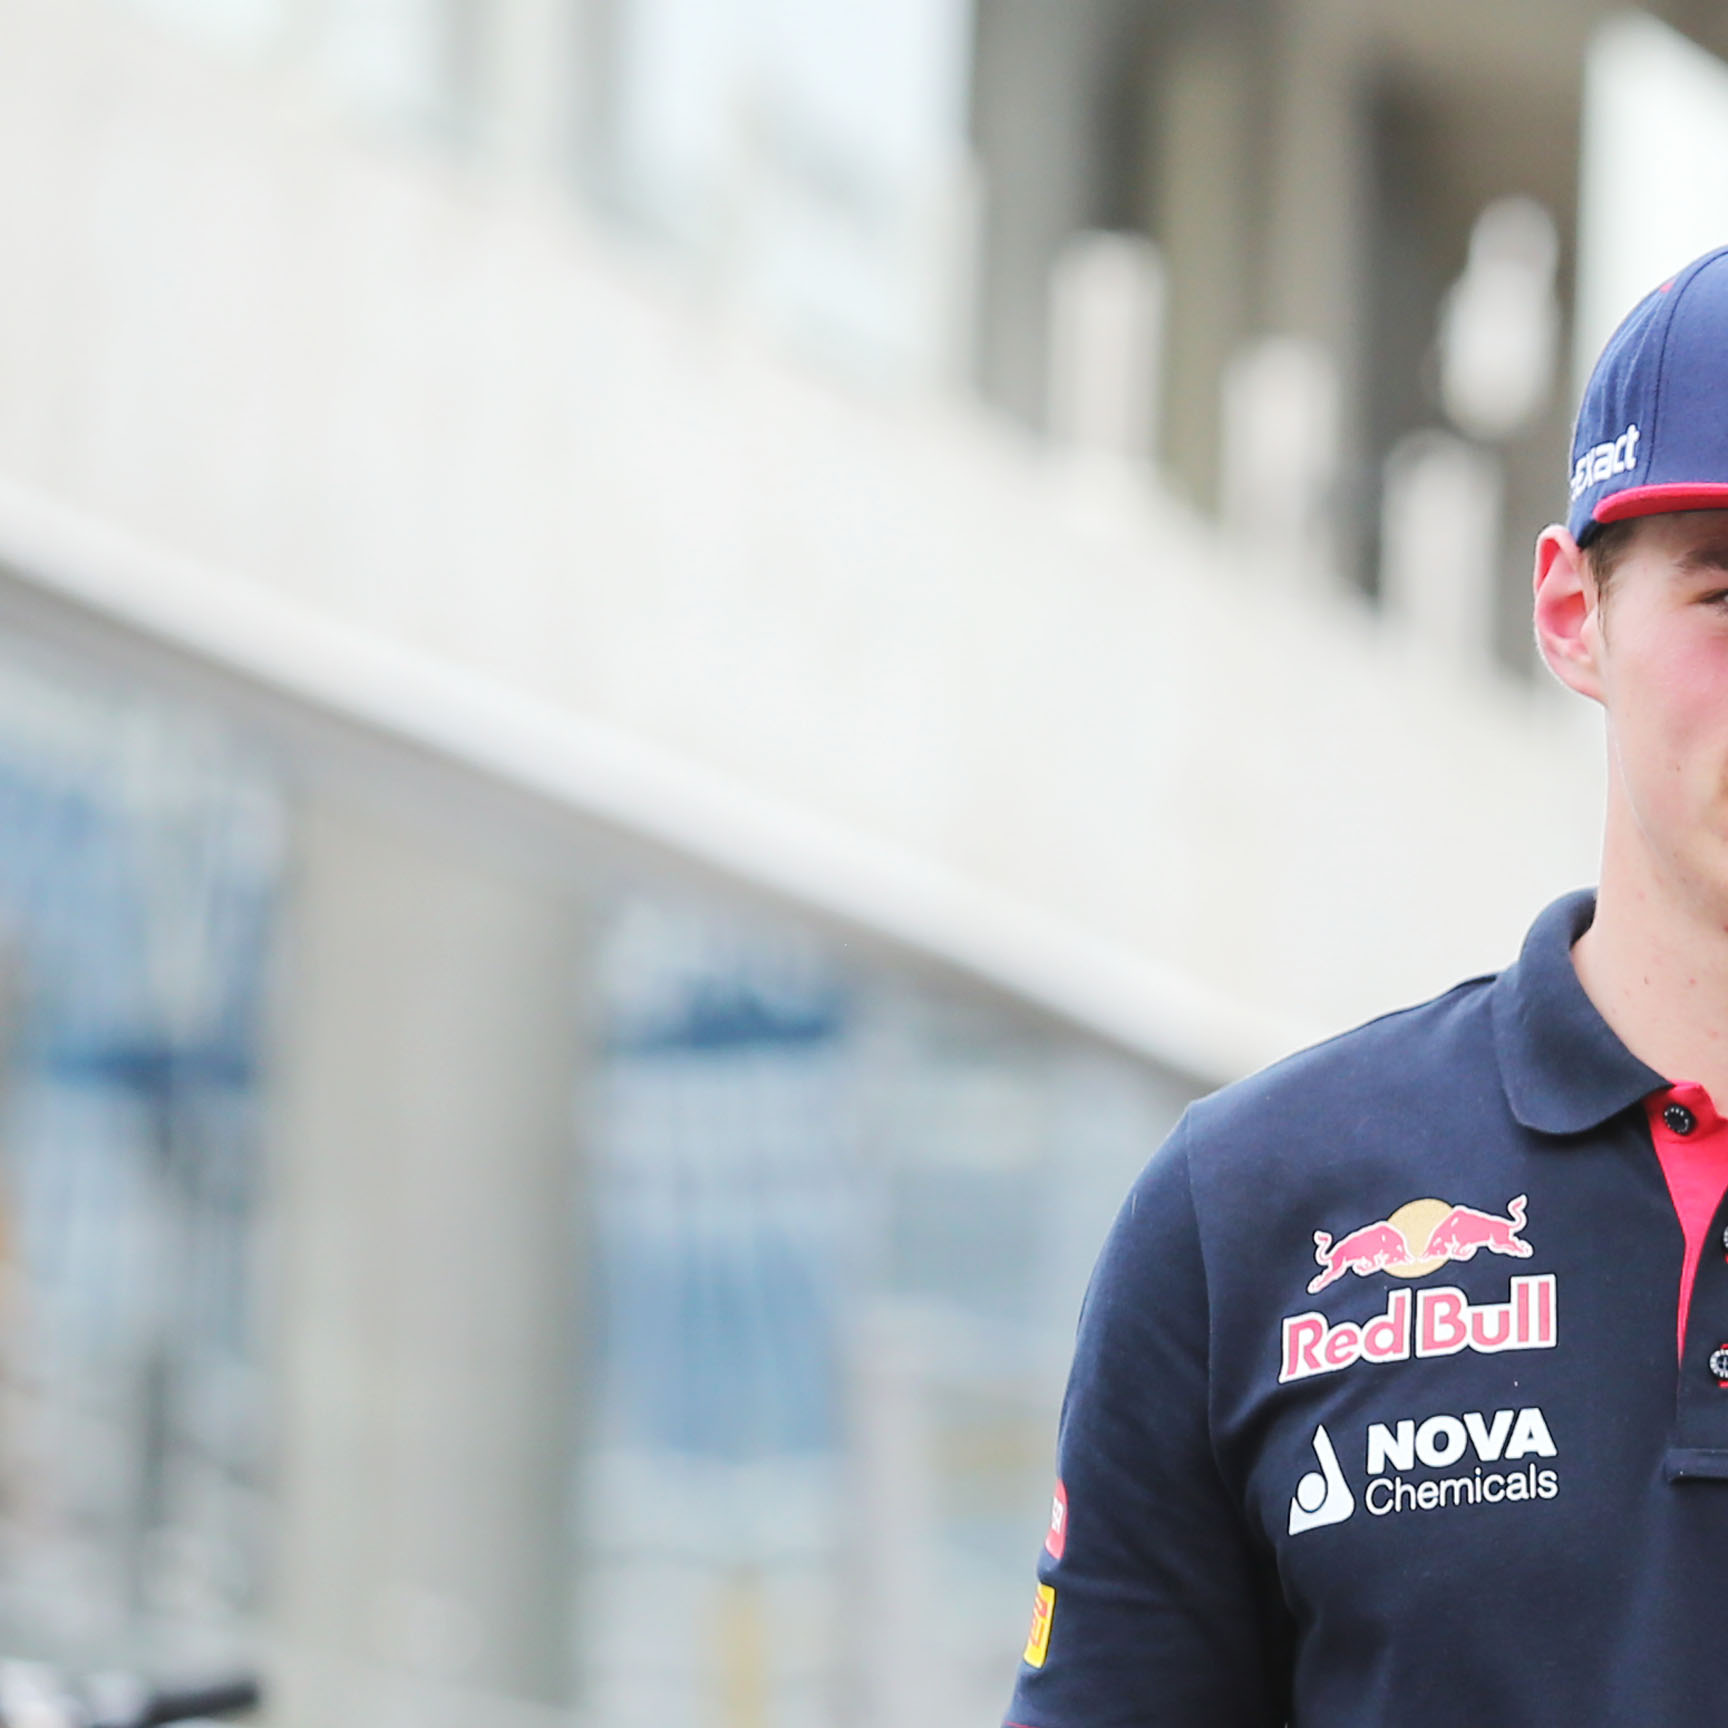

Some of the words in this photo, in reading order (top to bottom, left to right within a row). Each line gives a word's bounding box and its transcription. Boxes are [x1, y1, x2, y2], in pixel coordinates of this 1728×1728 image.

[1281, 1291, 1409, 1381] Red
[1417, 1276, 1555, 1355] Bull
[1366, 1406, 1558, 1475] NOVA
[1364, 1463, 1559, 1517] Chemicals
